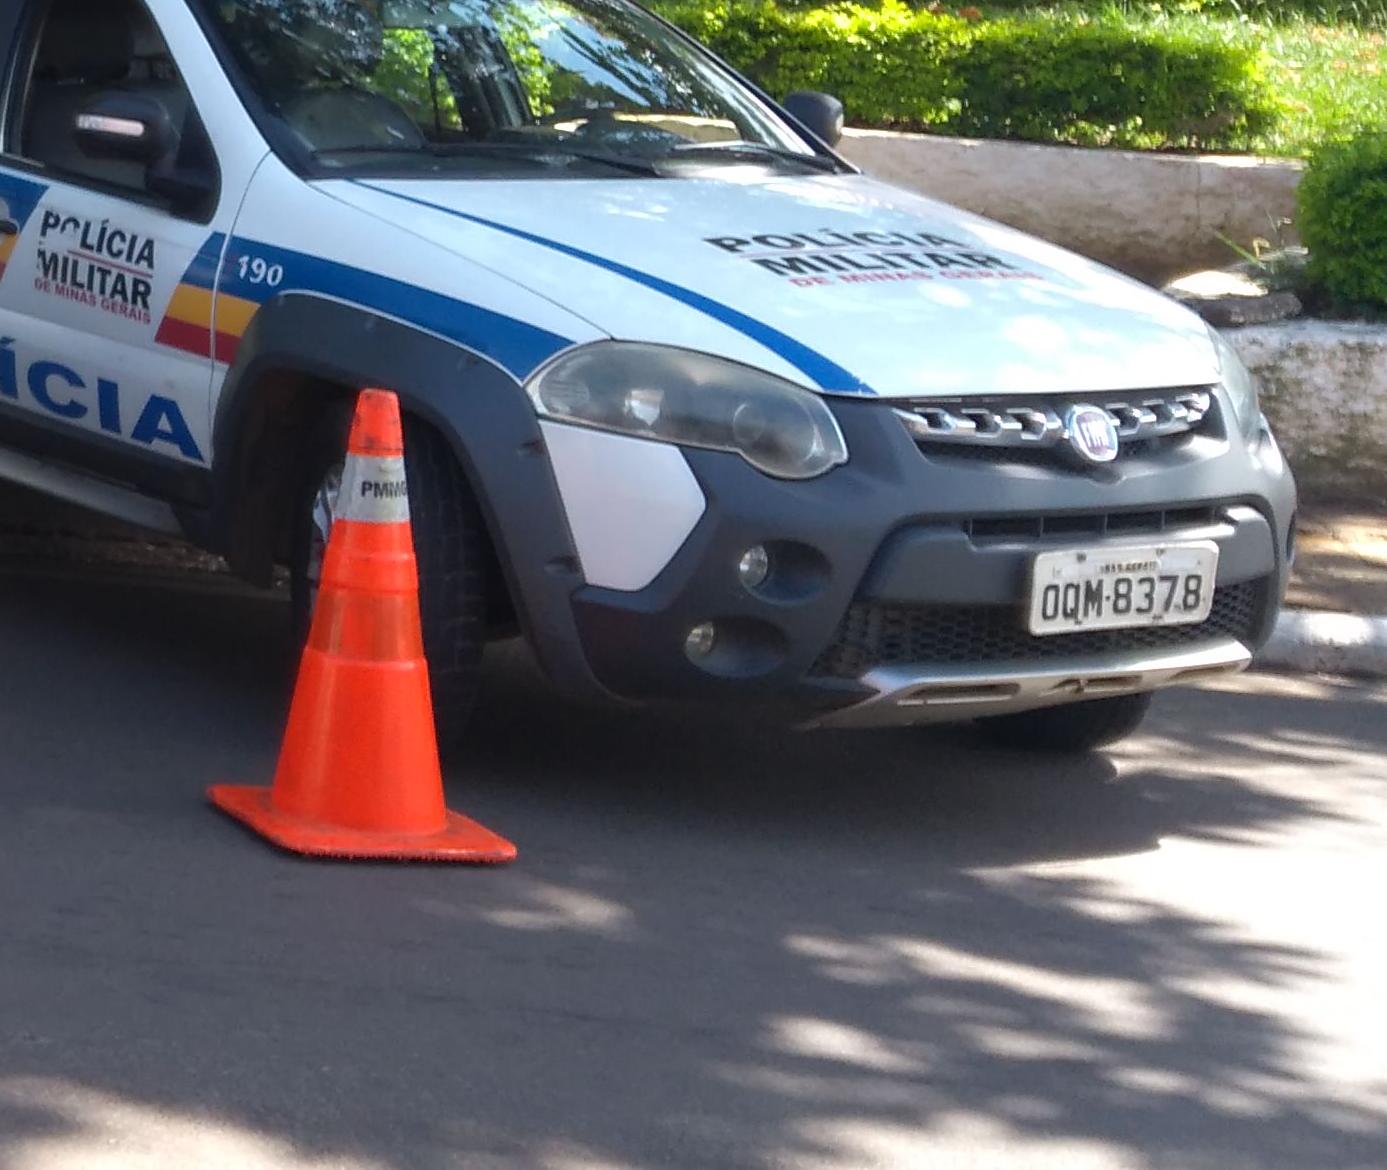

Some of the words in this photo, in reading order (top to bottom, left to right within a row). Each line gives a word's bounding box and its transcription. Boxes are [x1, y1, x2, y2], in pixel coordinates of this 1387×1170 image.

[702, 228, 973, 253] POLÍCIA
[238, 254, 283, 286] 190
[750, 252, 1019, 277] MILITAR
[36, 248, 152, 311] MILITAR
